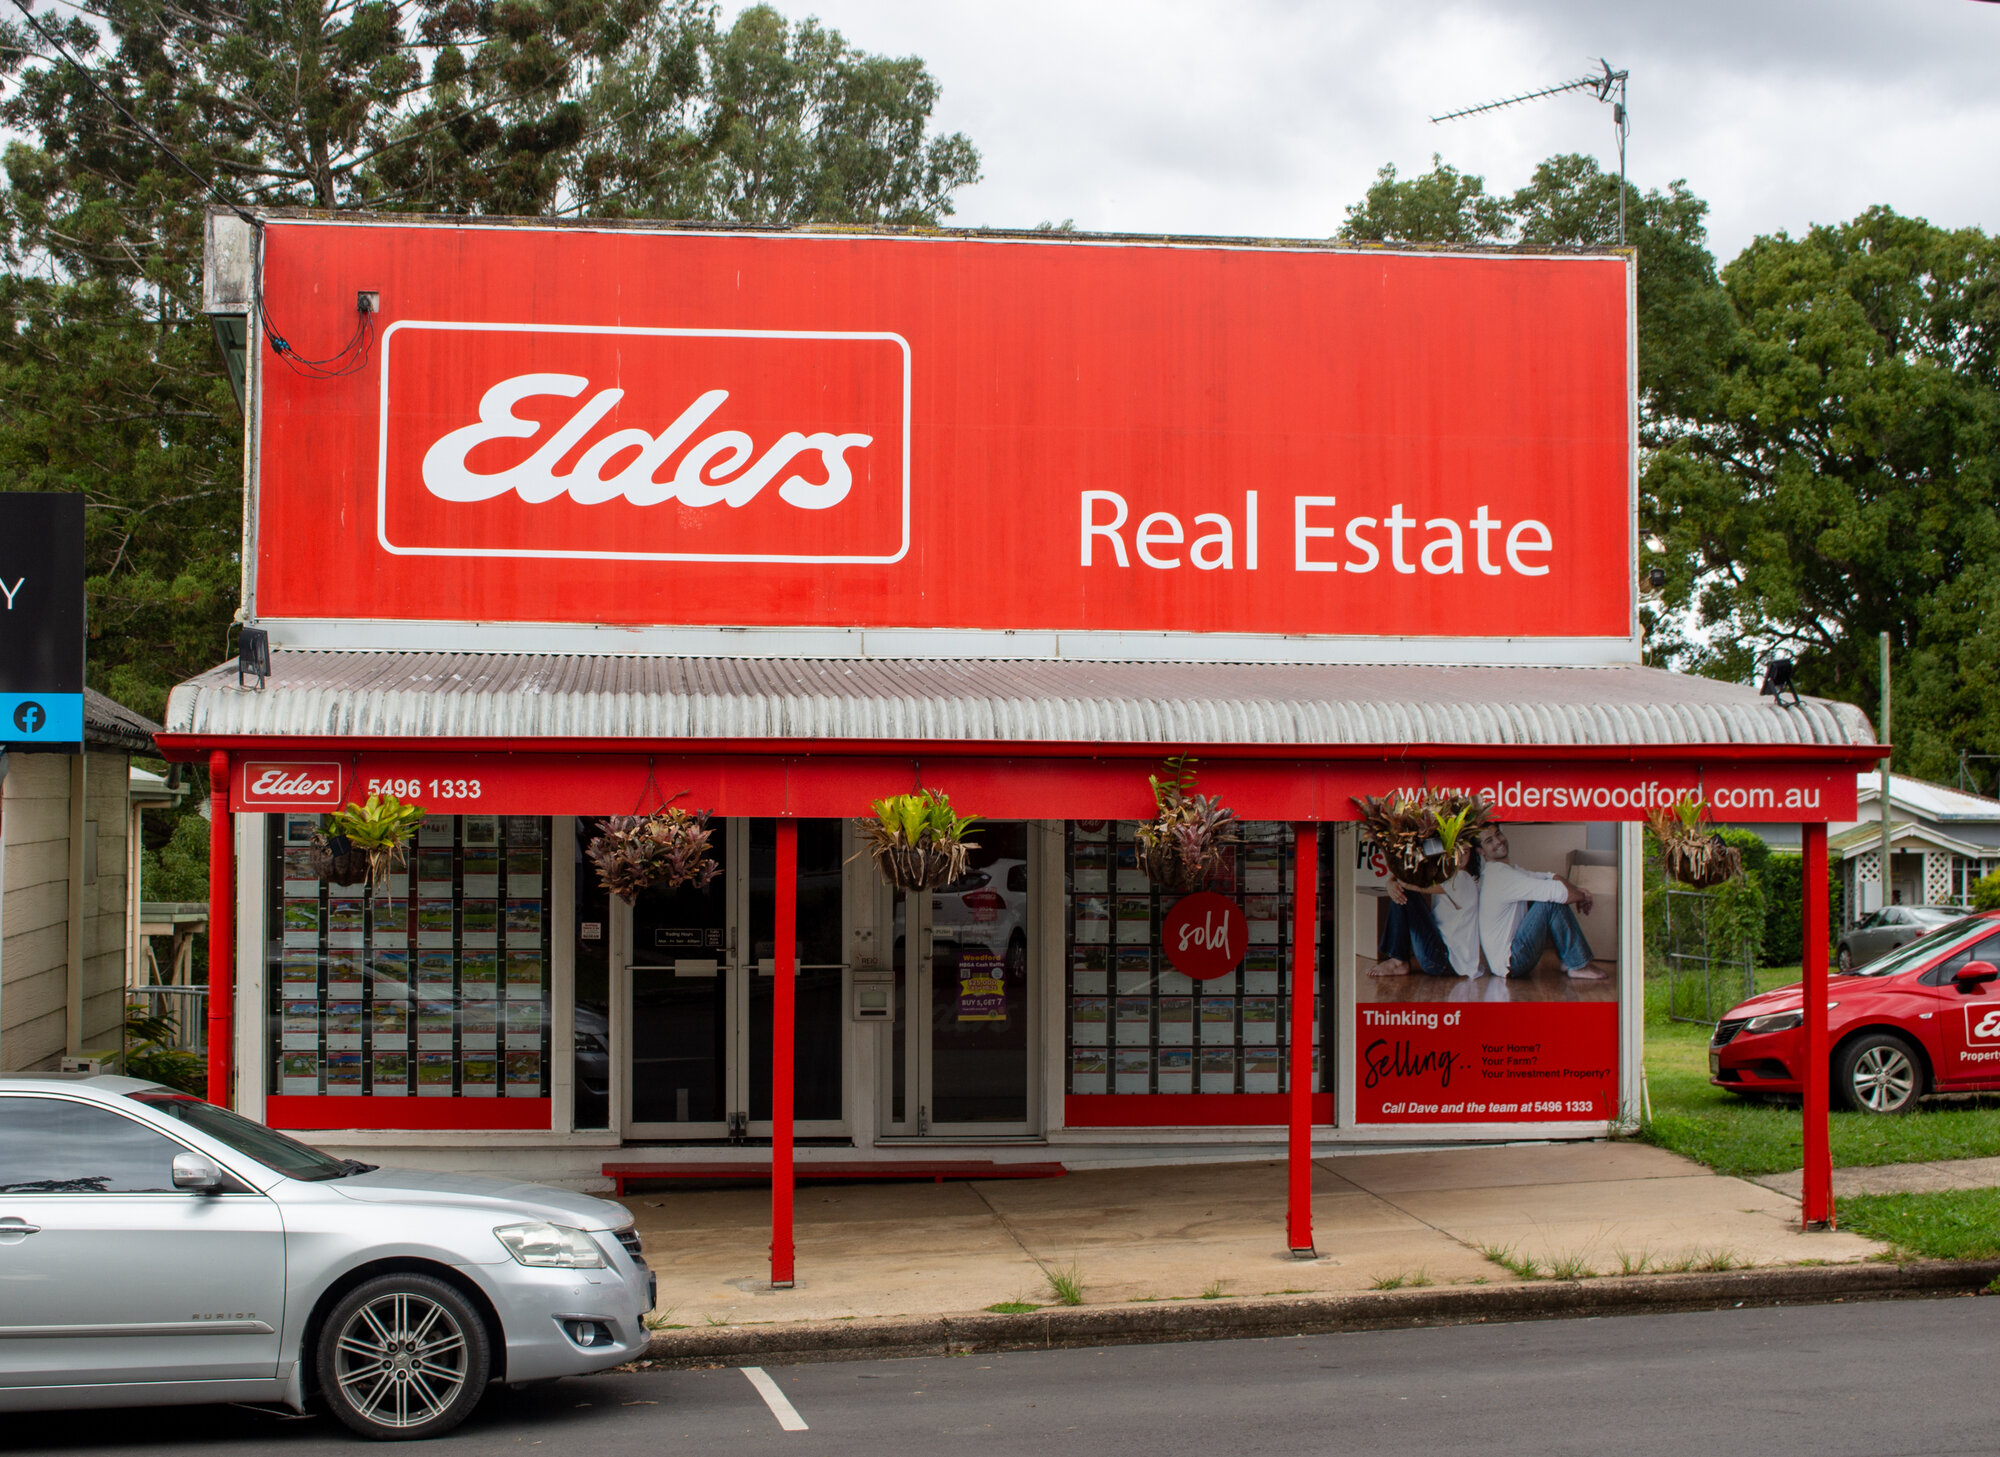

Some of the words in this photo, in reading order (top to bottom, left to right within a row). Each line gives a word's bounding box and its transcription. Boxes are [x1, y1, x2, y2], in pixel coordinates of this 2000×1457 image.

[422, 373, 873, 509] Elders
[1080, 490, 1258, 570] Real
[1294, 496, 1553, 576] Estate
[252, 770, 333, 797] Elders
[367, 779, 421, 799] 5496
[429, 779, 482, 799] 1333
[1178, 910, 1230, 959] sold
[963, 954, 1002, 962] Woodford
[1362, 1010, 1439, 1029] Thinking
[1443, 1010, 1461, 1026] of
[1481, 1043, 1504, 1053] Your
[1506, 1043, 1541, 1053] Home?
[1481, 1056, 1504, 1066] Your
[1506, 1056, 1538, 1066] Farm?
[1481, 1069, 1504, 1079] Your
[1506, 1069, 1560, 1078] Investment
[1562, 1068, 1611, 1079] Property?
[1382, 1102, 1405, 1113] Call
[1408, 1102, 1439, 1113] Dave
[1441, 1102, 1465, 1113] and
[1466, 1102, 1487, 1113] the
[1489, 1102, 1518, 1113] team
[1520, 1102, 1533, 1113] at
[1534, 1101, 1563, 1113] 5496
[1565, 1101, 1593, 1112] 1333
